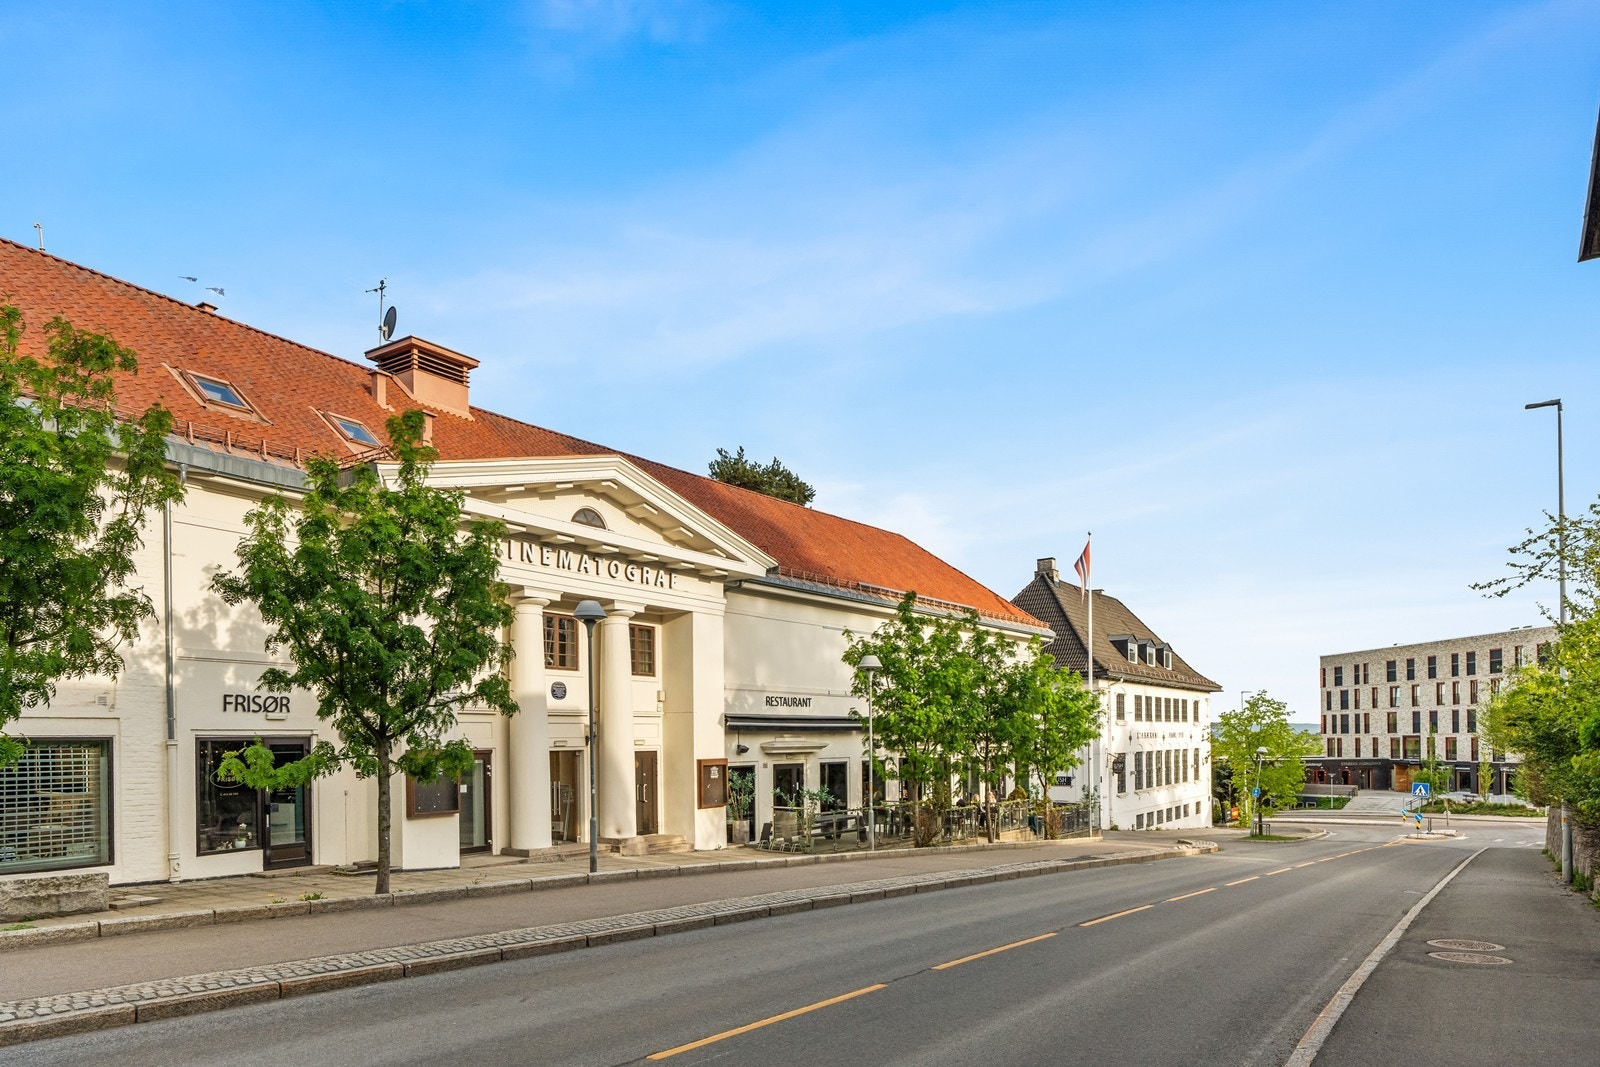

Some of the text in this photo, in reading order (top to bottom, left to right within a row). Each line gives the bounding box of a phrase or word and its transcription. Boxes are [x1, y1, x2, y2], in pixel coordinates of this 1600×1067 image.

[495, 539, 678, 589] INEMATOGRAF
[223, 694, 290, 713] FRISØR
[765, 696, 812, 707] RESTAURANT
